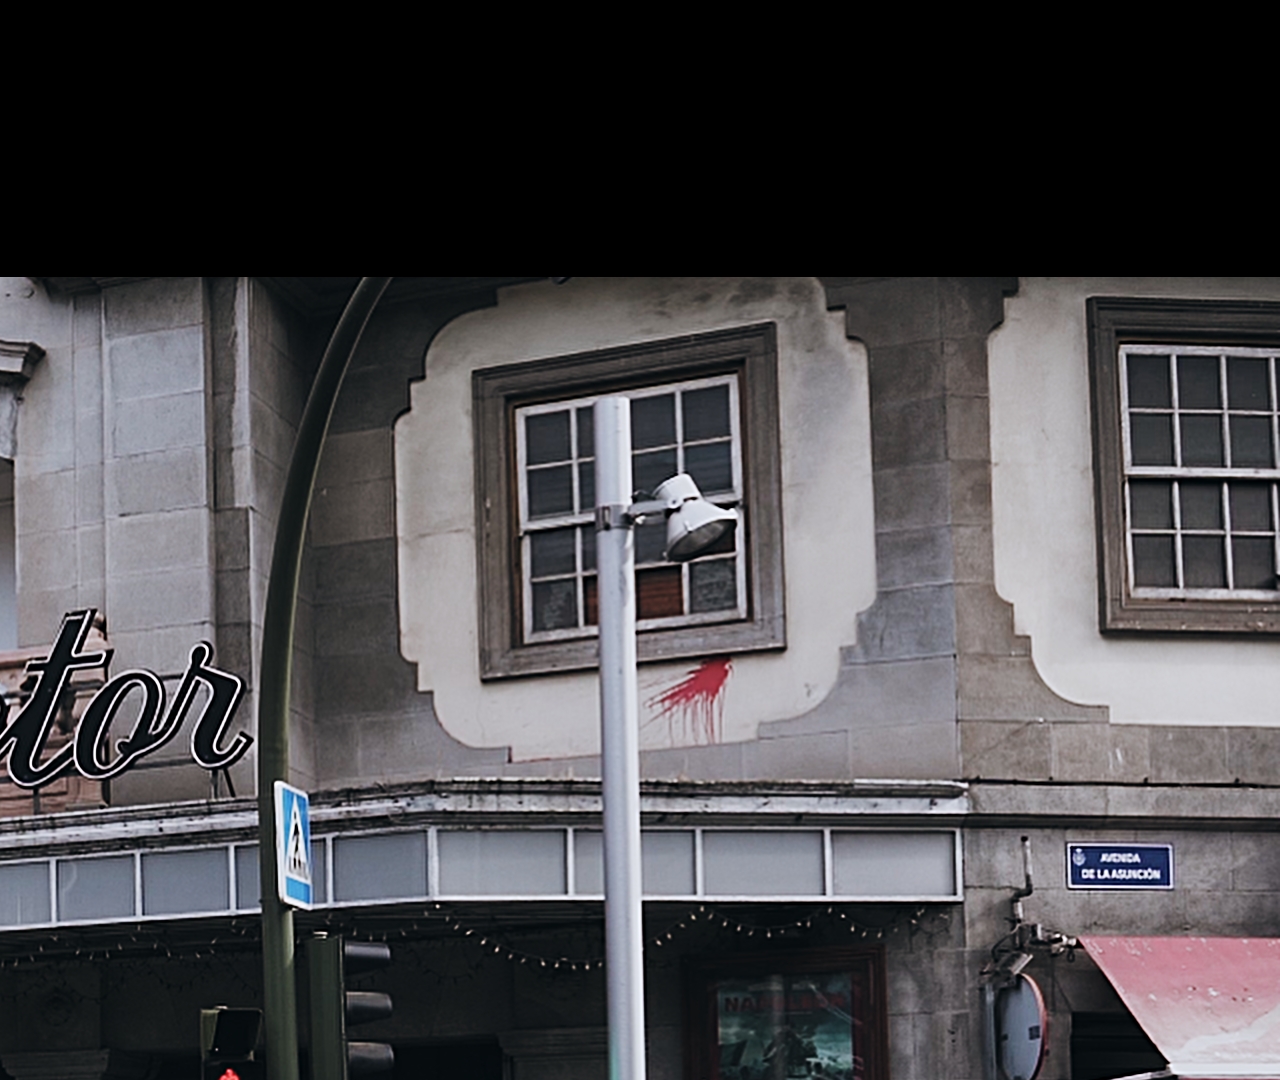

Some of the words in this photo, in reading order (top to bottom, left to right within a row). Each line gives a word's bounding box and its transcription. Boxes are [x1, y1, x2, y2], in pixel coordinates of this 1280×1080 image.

[1100, 853, 1141, 863] AVENIDA
[1081, 868, 1095, 879] DE
[1097, 868, 1110, 879] LA
[1111, 867, 1160, 880] ASUNCIÓN
